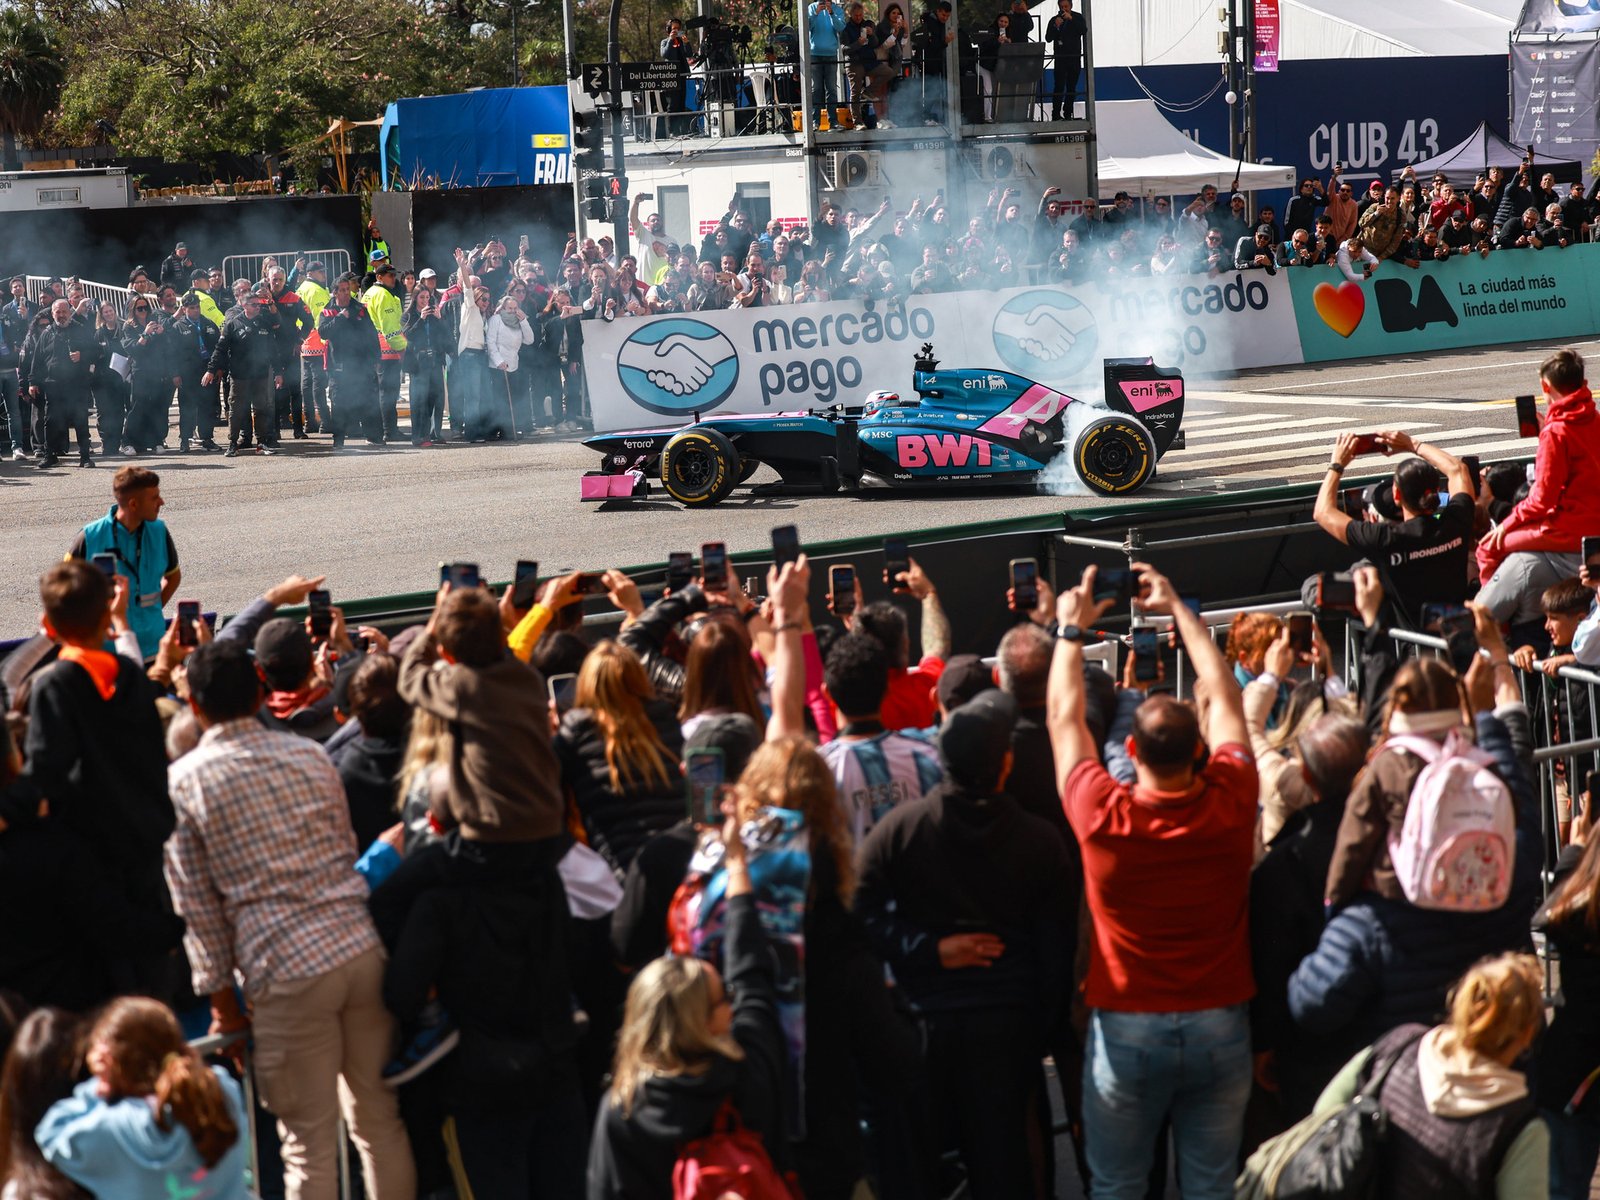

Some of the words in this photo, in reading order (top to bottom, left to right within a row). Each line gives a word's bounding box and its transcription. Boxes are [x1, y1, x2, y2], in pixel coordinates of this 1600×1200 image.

[629, 72, 641, 80] Del
[642, 72, 677, 80] Libertador
[640, 81, 656, 89] 3700
[1055, 135, 1085, 143] 861399
[1309, 122, 1389, 171] CLUB
[1397, 118, 1439, 164] 43
[786, 148, 803, 157] Basani
[0, 181, 12, 189] ani
[1458, 281, 1477, 296] La
[1481, 276, 1525, 294] ciudad
[1528, 274, 1556, 289] más
[1110, 273, 1269, 322] mercado
[1374, 275, 1459, 333] BA
[1463, 302, 1498, 317] linda
[1499, 299, 1519, 314] del
[1522, 295, 1566, 312] mundo
[753, 301, 936, 353] mercado
[760, 355, 863, 406] pago
[962, 377, 986, 389] eni
[1130, 384, 1153, 396] eni
[1145, 412, 1175, 420] IndraMind
[871, 431, 893, 439] MSC
[1102, 424, 1112, 433] P
[1115, 424, 1147, 451] ZERO
[709, 443, 719, 451] P
[897, 434, 993, 468] BWT
[613, 456, 627, 464] FIA
[711, 455, 725, 493] ZERO
[1409, 536, 1463, 560] IRONDRIVER
